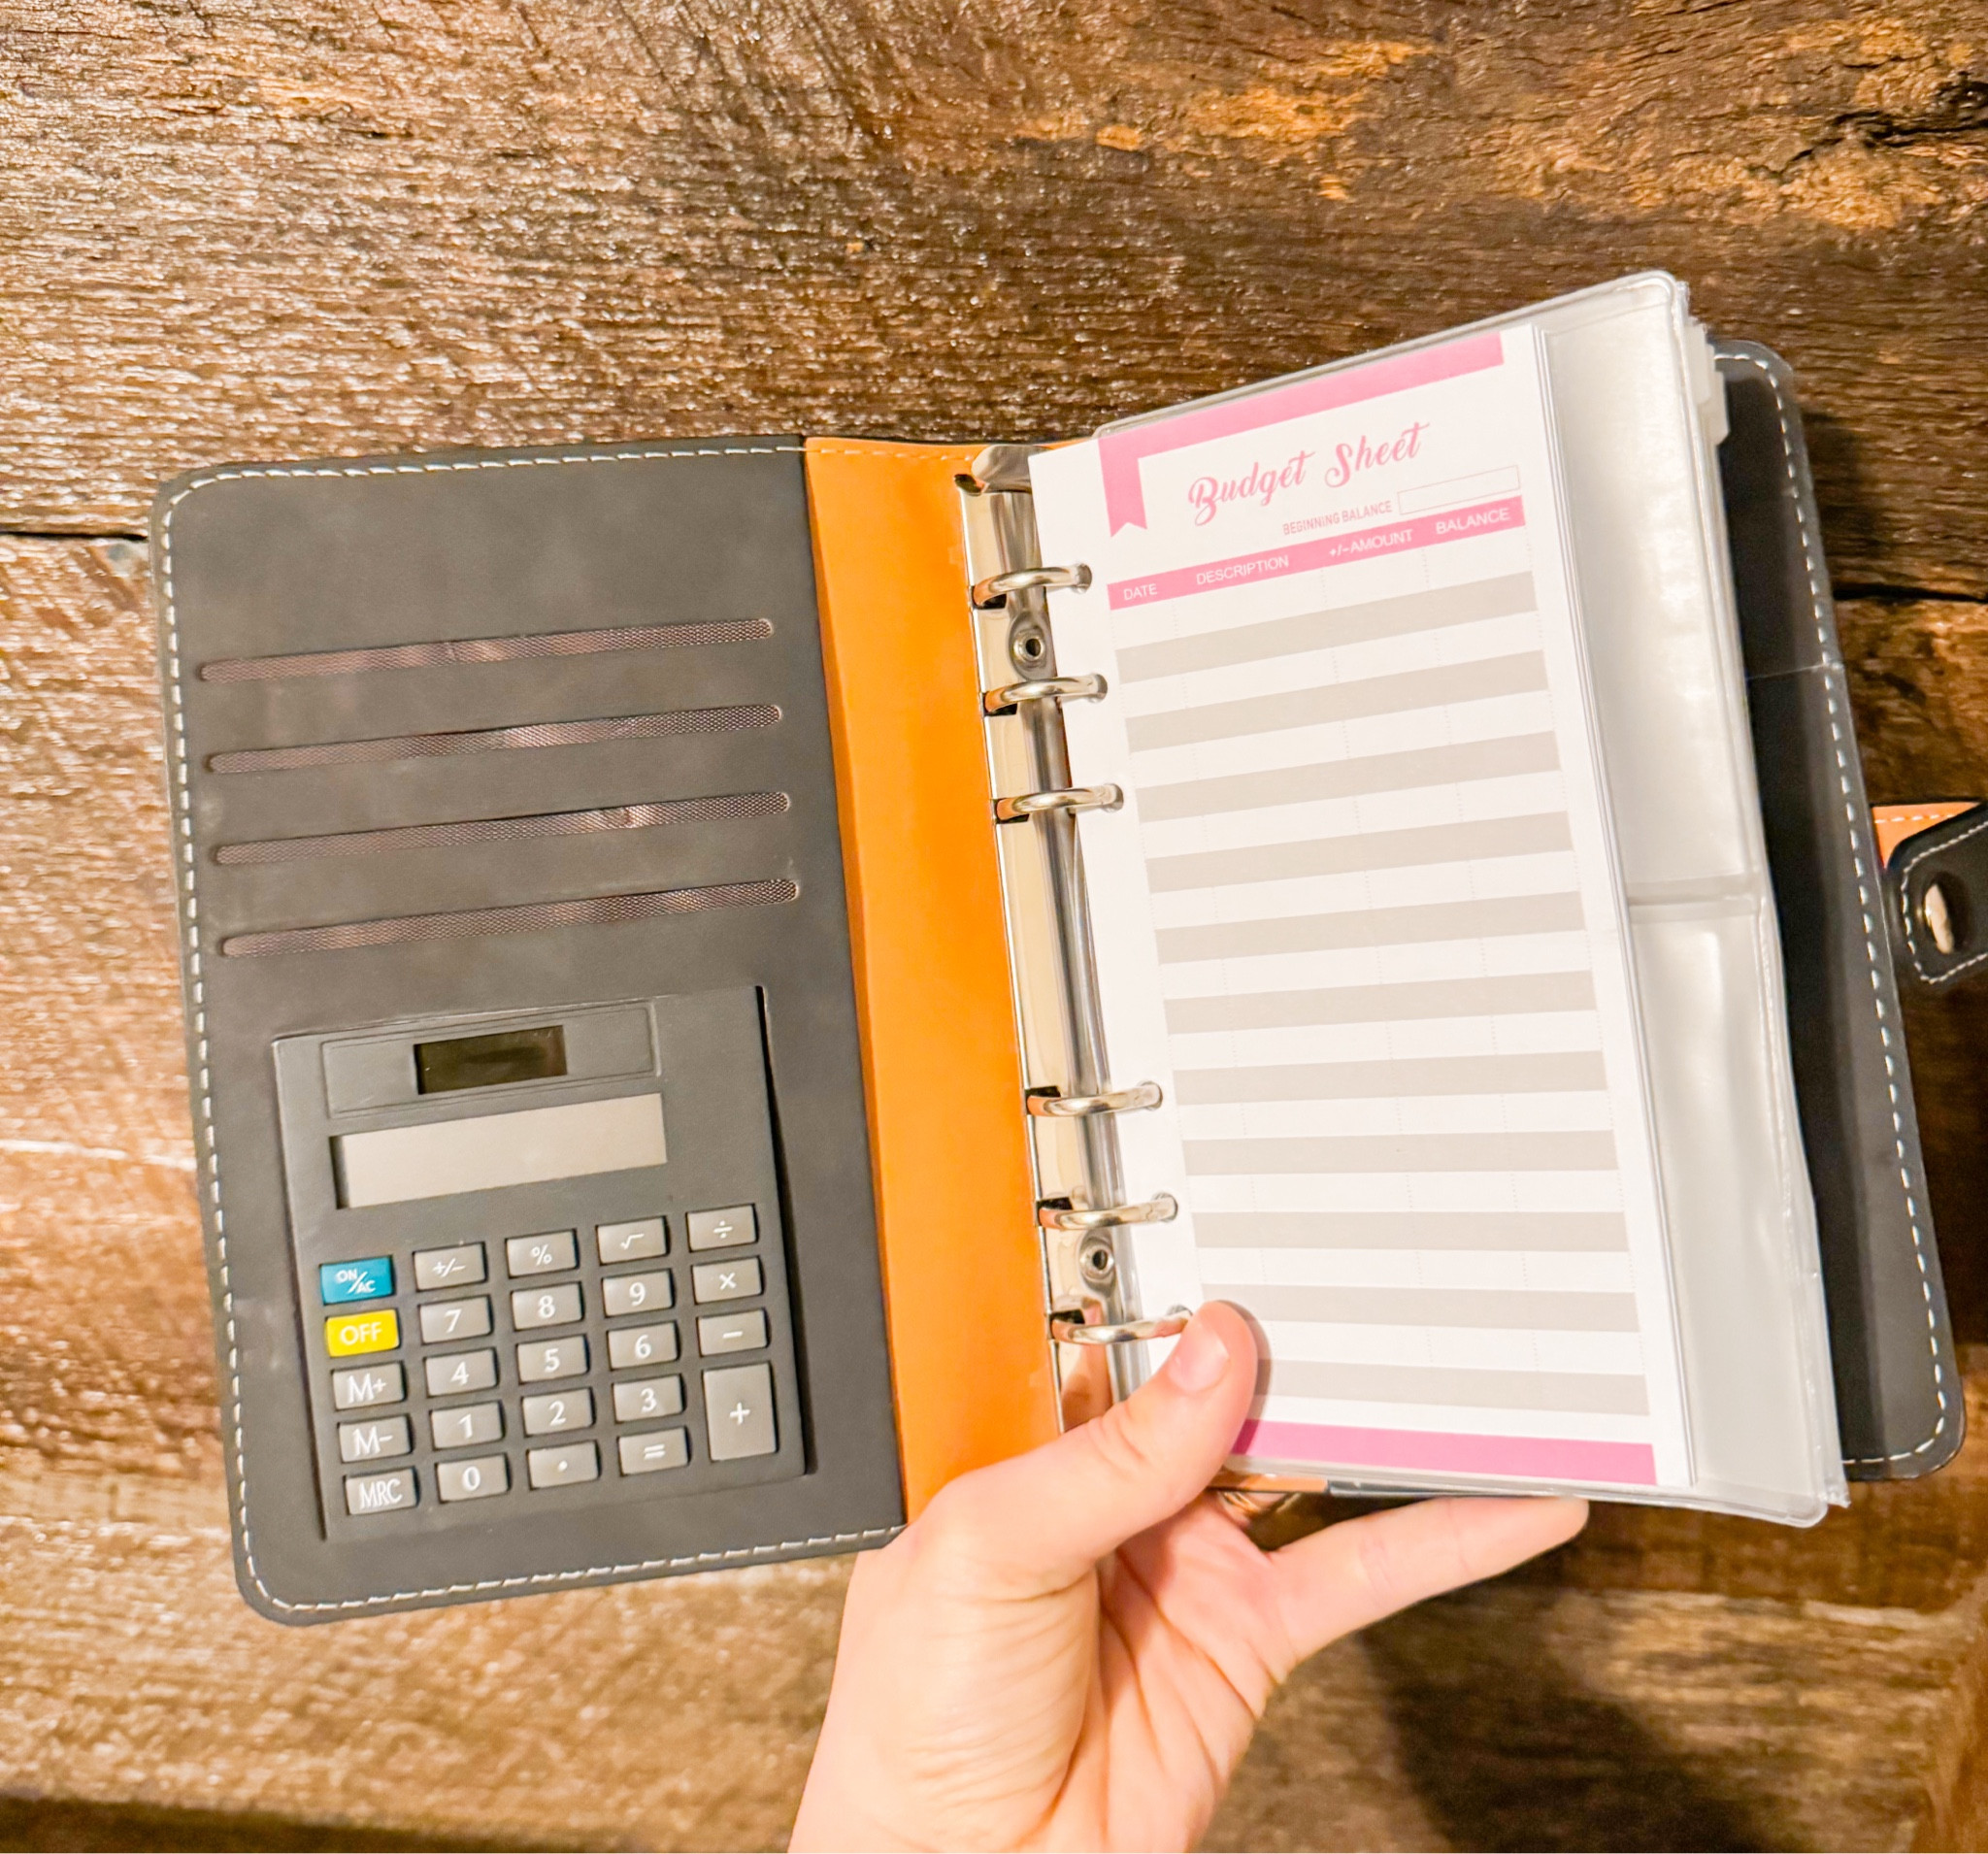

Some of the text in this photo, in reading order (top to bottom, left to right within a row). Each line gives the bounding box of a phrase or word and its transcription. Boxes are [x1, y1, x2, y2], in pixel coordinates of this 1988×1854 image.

[1189, 421, 1430, 526] Budget Sheet
[1282, 500, 1392, 536] BEGINNING BALANCE
[1123, 583, 1157, 601] DATE
[1196, 554, 1289, 584] DESCRIPTION
[1436, 507, 1510, 535] BALANCE
[629, 1281, 646, 1306] 9
[538, 1295, 555, 1318] 8
[445, 1308, 462, 1333] 7
[340, 1322, 382, 1345] OFF
[635, 1334, 651, 1359] 6
[451, 1361, 469, 1385] 4
[544, 1348, 560, 1373] 5
[641, 1388, 657, 1412] 3
[458, 1413, 473, 1439] 1
[549, 1401, 566, 1426] 2
[461, 1466, 481, 1491] 0
[359, 1478, 404, 1508] MRC
